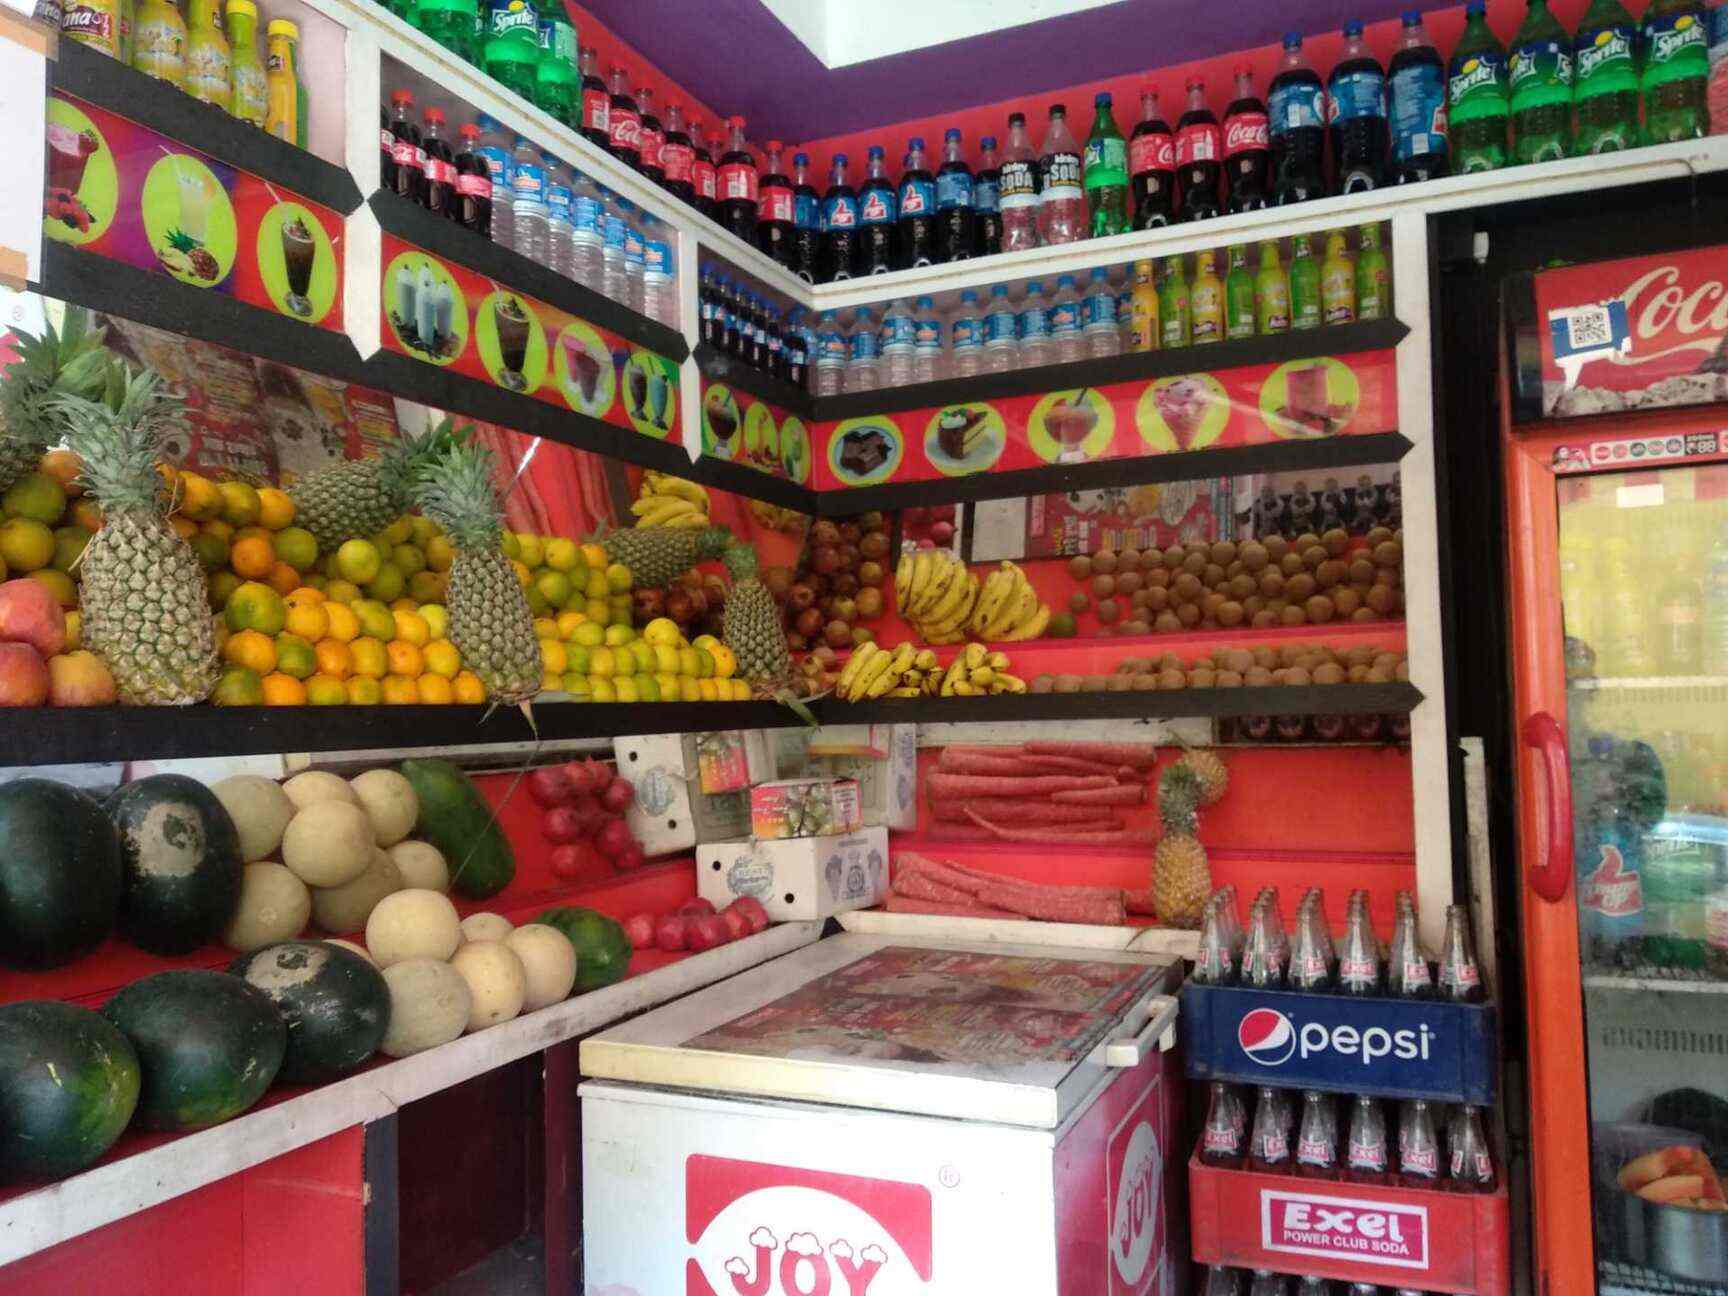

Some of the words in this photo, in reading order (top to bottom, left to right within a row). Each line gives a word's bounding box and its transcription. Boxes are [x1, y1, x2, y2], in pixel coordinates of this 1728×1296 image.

[493, 9, 535, 32] Sprite
[1579, 37, 1626, 75] Sprite
[1656, 26, 1706, 61] Sprite
[1451, 65, 1492, 104] Sprite
[1000, 171, 1034, 191] SODA
[1300, 1023, 1430, 1065] pepsi
[1283, 1201, 1405, 1243] Exel
[725, 1226, 888, 1296] JOY
[1283, 1229, 1331, 1246] POWER
[1332, 1235, 1369, 1251] CLUB
[1371, 1240, 1410, 1256] SODA
